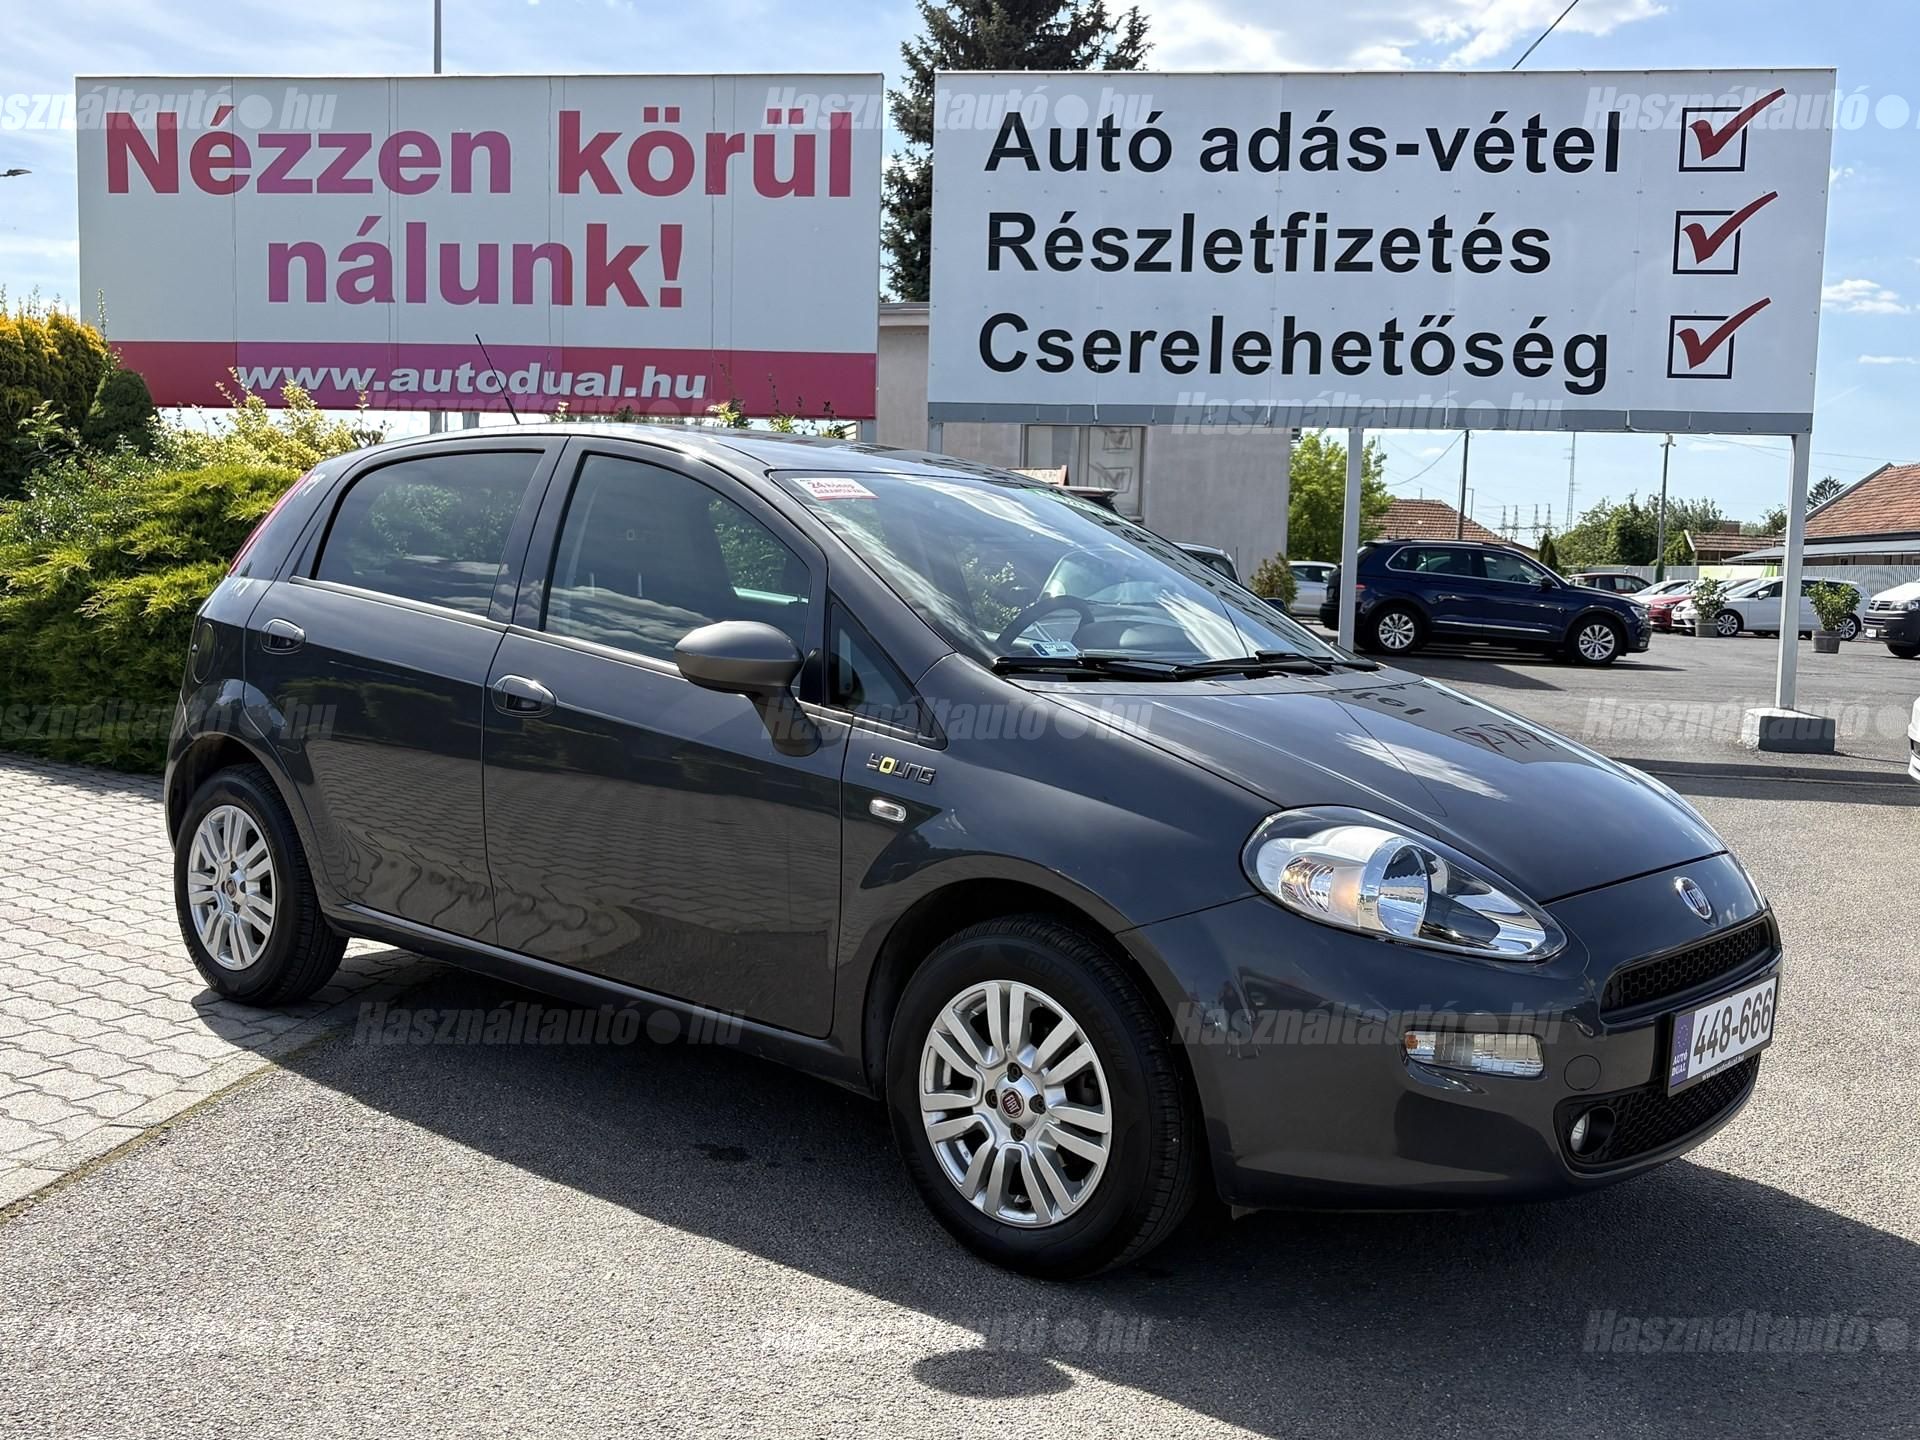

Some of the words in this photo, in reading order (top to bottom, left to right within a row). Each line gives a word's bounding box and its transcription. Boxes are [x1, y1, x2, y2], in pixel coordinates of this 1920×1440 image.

[106, 106, 512, 195] Nézzen
[559, 107, 853, 198] körül
[985, 111, 1173, 173] Autó
[1200, 109, 1620, 174] adás-vétel
[268, 216, 683, 308] nálunk!
[987, 211, 1552, 275] Részletfizetés
[237, 362, 706, 398] www.autodual.hu
[979, 312, 1609, 396] Cserelehetőség
[866, 753, 936, 785] YOUNG
[1693, 987, 1772, 1064] 448-666
[1005, 1094, 1020, 1113] FIAT
